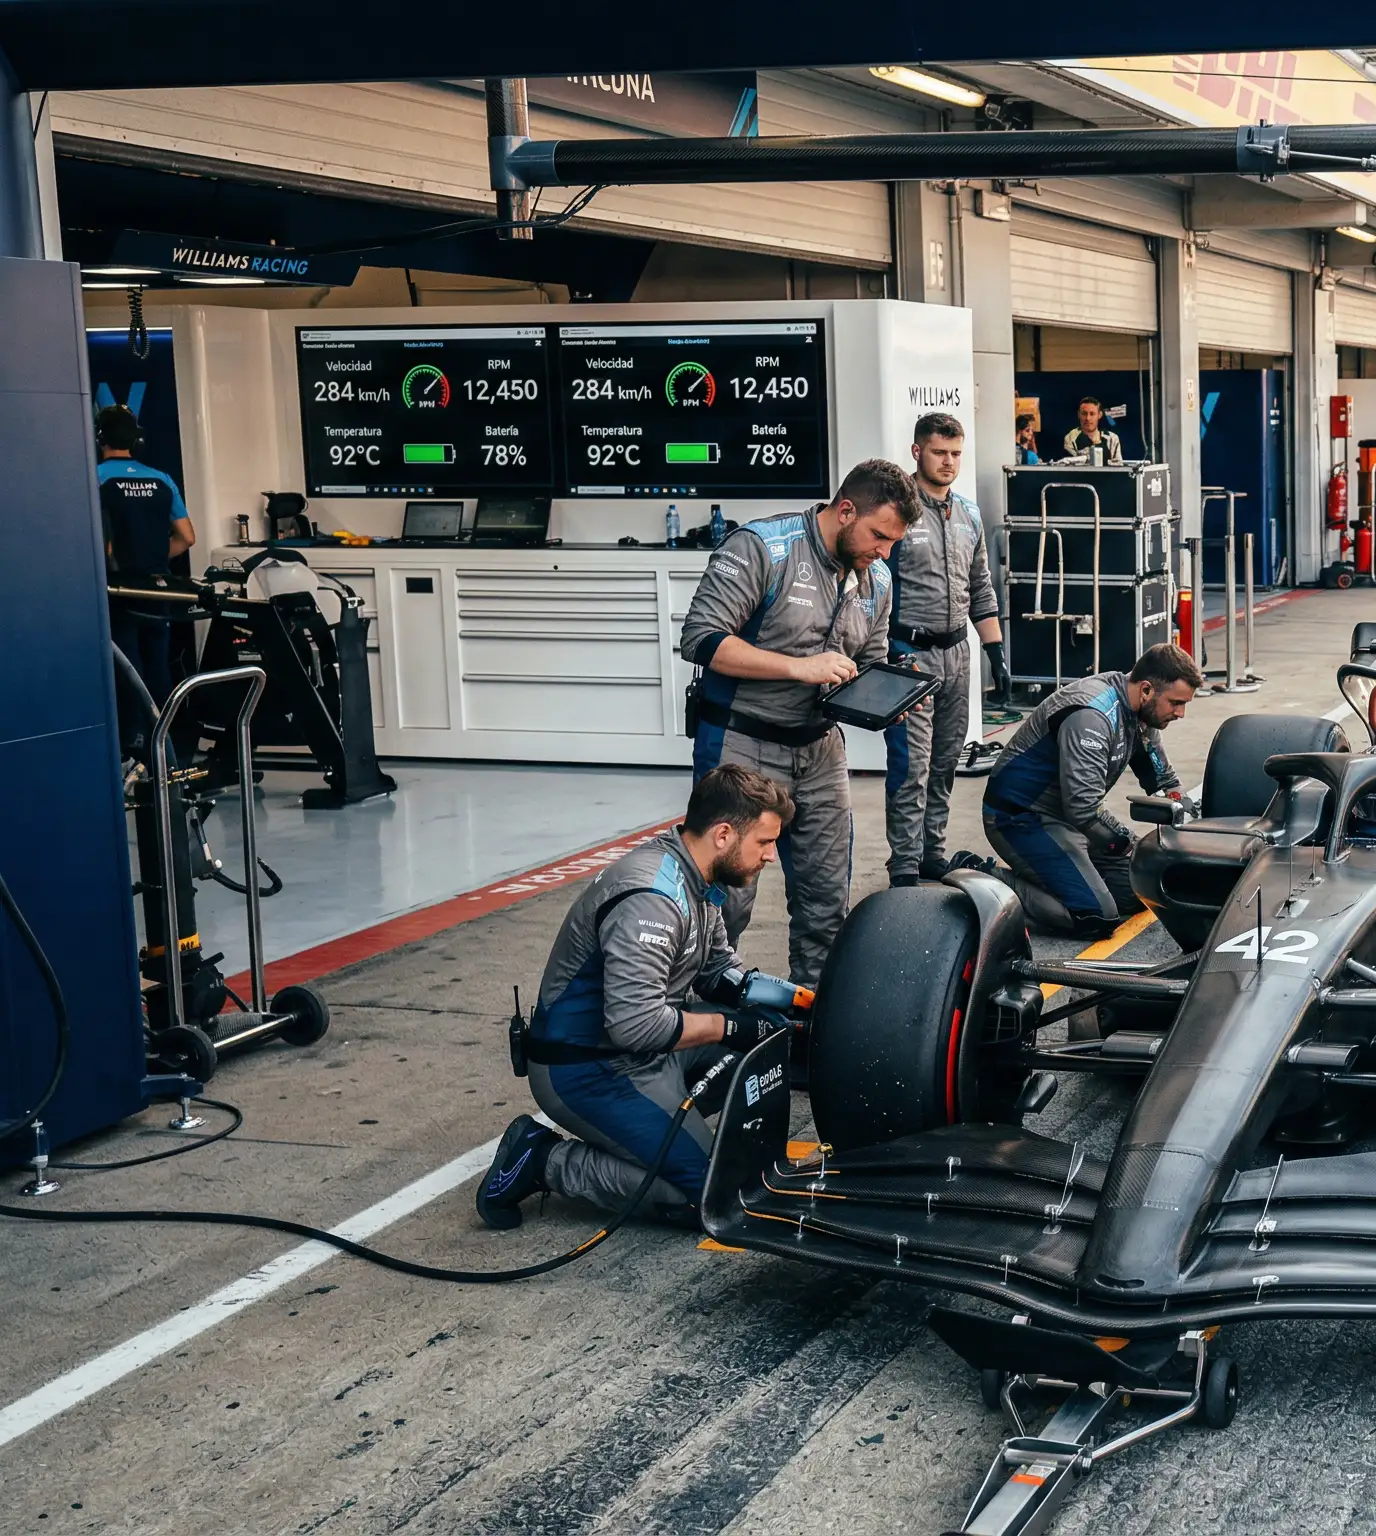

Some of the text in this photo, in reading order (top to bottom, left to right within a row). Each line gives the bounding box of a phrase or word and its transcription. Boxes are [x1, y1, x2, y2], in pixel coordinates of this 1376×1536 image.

[172, 247, 308, 275] WILLIAMS RACING
[326, 361, 372, 372] Velocidad
[487, 360, 511, 370] RPM
[585, 357, 634, 369] Velocidad
[755, 356, 780, 367] RPM
[314, 381, 391, 402] 284 km/h
[463, 379, 538, 405] 12,450
[571, 378, 652, 401] 284 km/h
[729, 377, 809, 403] 12,450
[908, 386, 961, 407] WILLIAMS
[324, 426, 382, 438] Temperatura
[485, 425, 519, 436] Batería
[581, 425, 643, 438] Temperatura
[752, 424, 787, 435] Batería
[329, 445, 381, 466] 92°C
[480, 445, 527, 466] 78%
[587, 444, 641, 466] 92°C
[746, 444, 796, 466] 78%
[1214, 926, 1319, 965] 42
